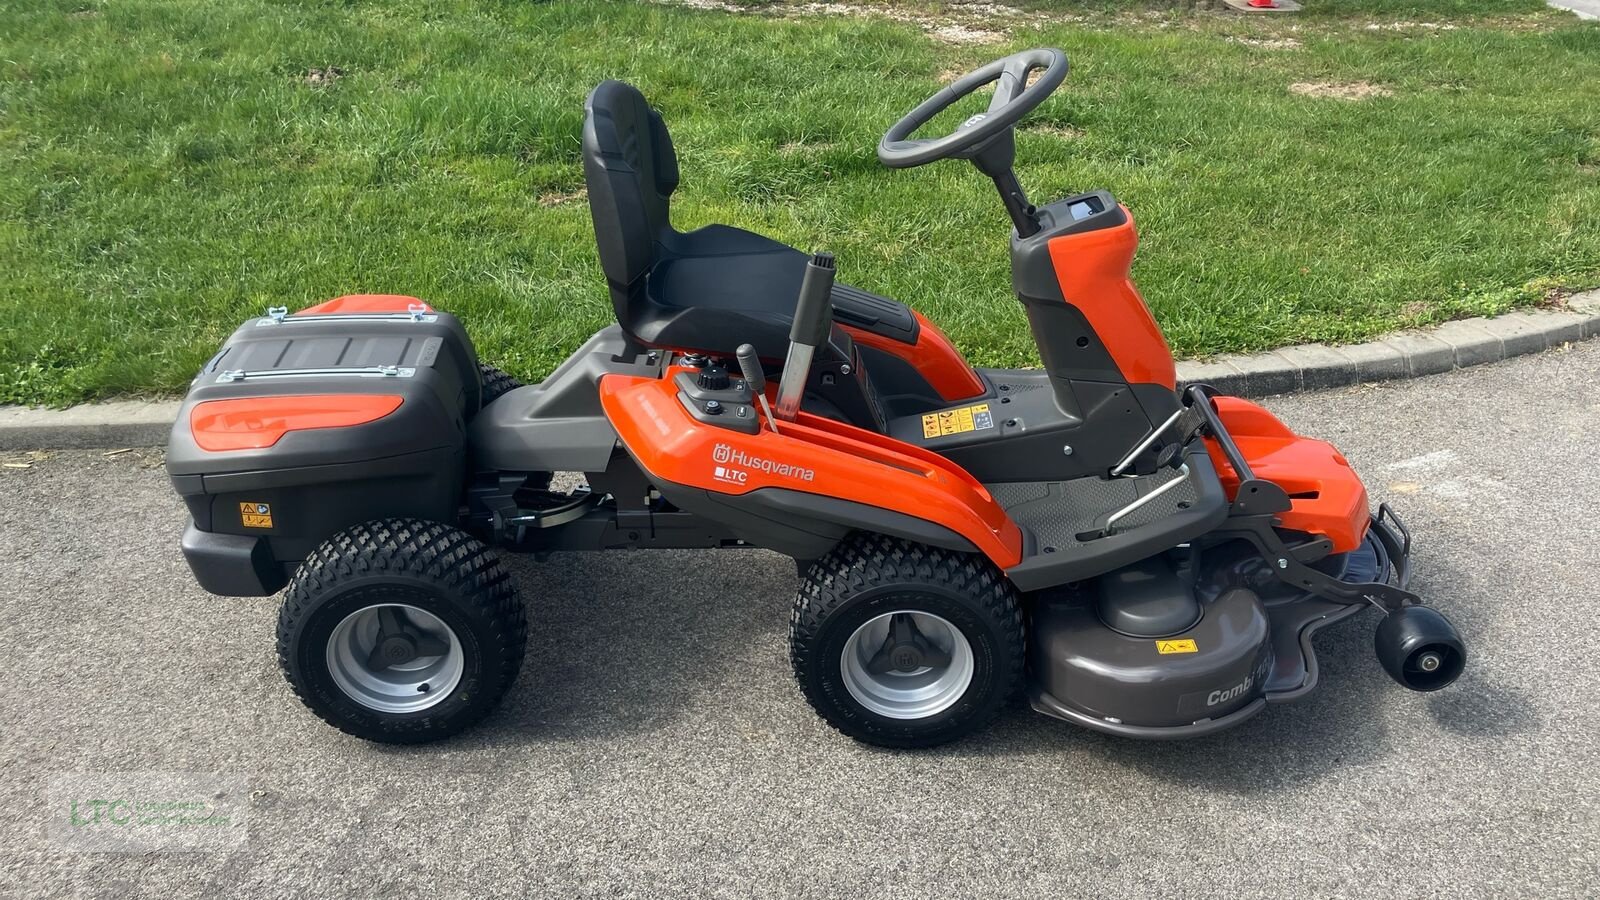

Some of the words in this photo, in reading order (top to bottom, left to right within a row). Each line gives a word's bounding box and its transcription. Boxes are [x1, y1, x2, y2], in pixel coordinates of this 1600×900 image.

[725, 469, 748, 482] LTC
[731, 450, 814, 481] Husqvarna
[1207, 672, 1255, 706] Combi
